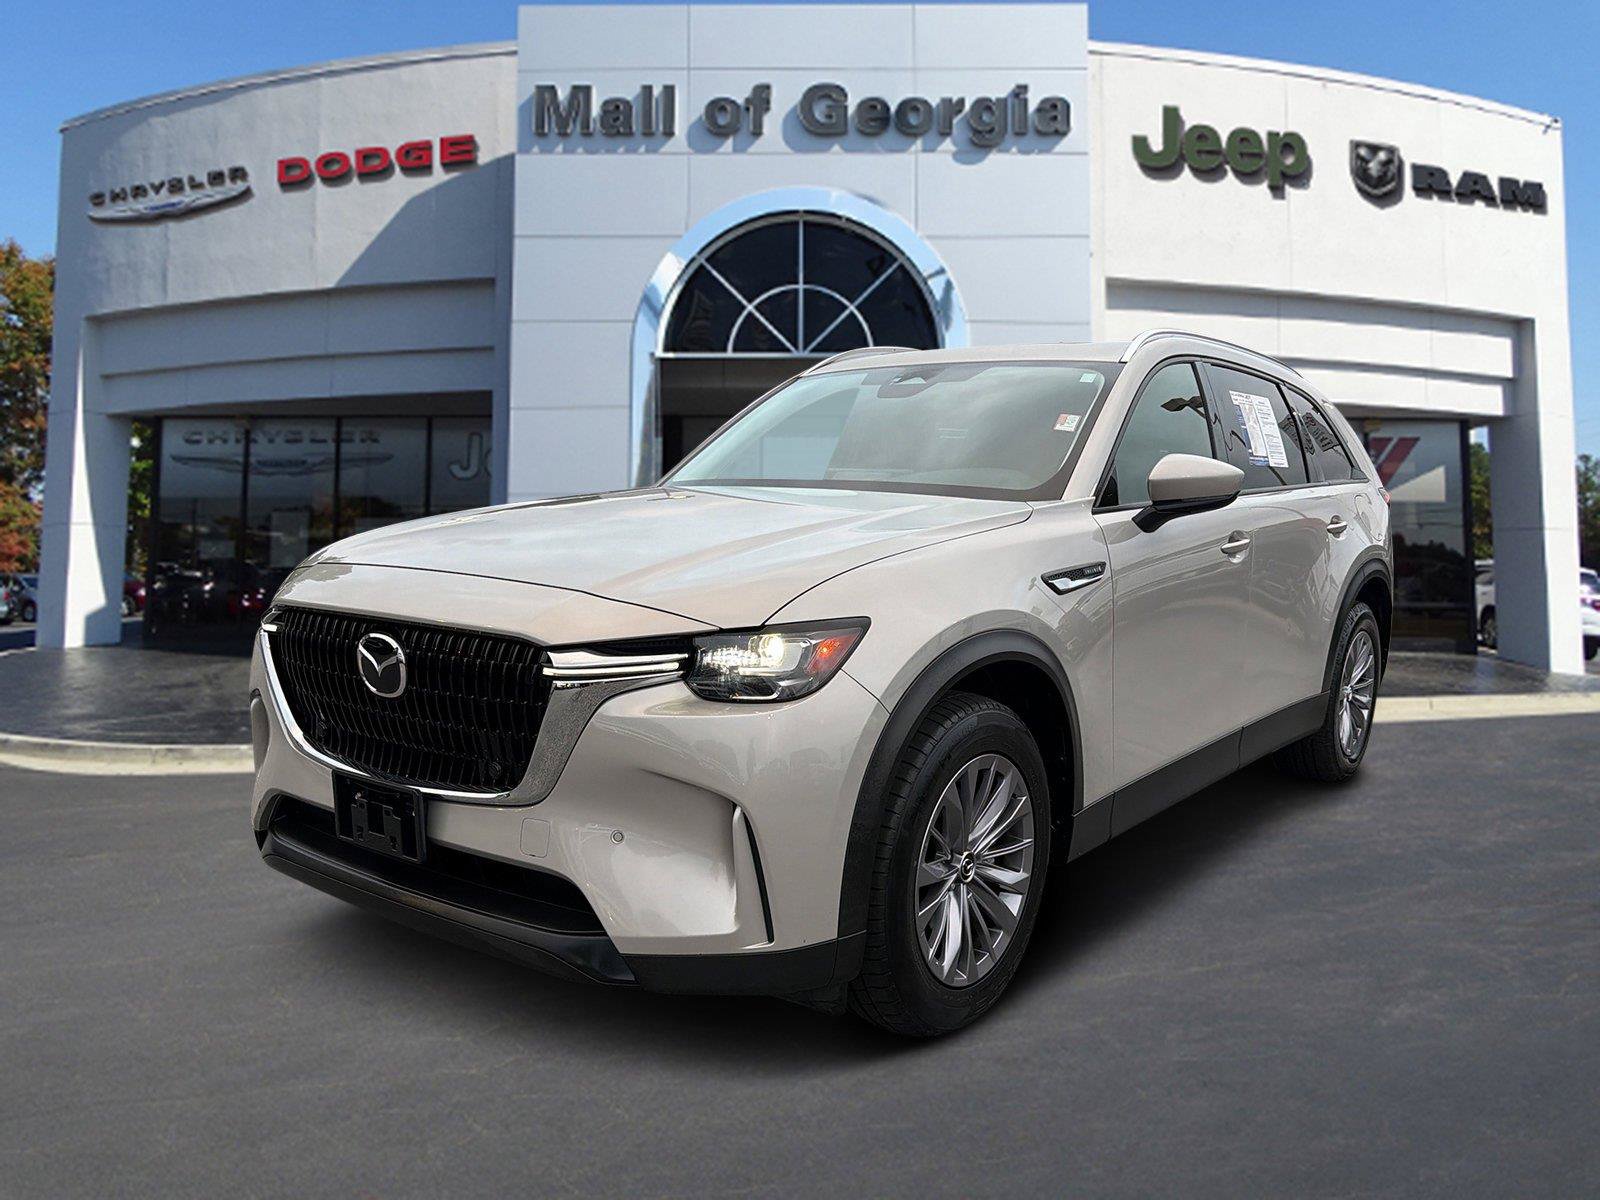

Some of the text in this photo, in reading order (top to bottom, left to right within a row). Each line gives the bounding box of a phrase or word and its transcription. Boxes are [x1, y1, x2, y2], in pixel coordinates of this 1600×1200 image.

[534, 82, 1073, 148] Mall of Georgia
[277, 134, 477, 187] DODGE
[1131, 105, 1309, 192] Jeep
[89, 166, 249, 206] CHRYSLER
[1412, 163, 1546, 211] RAM
[183, 429, 381, 445] CHRYSLER
